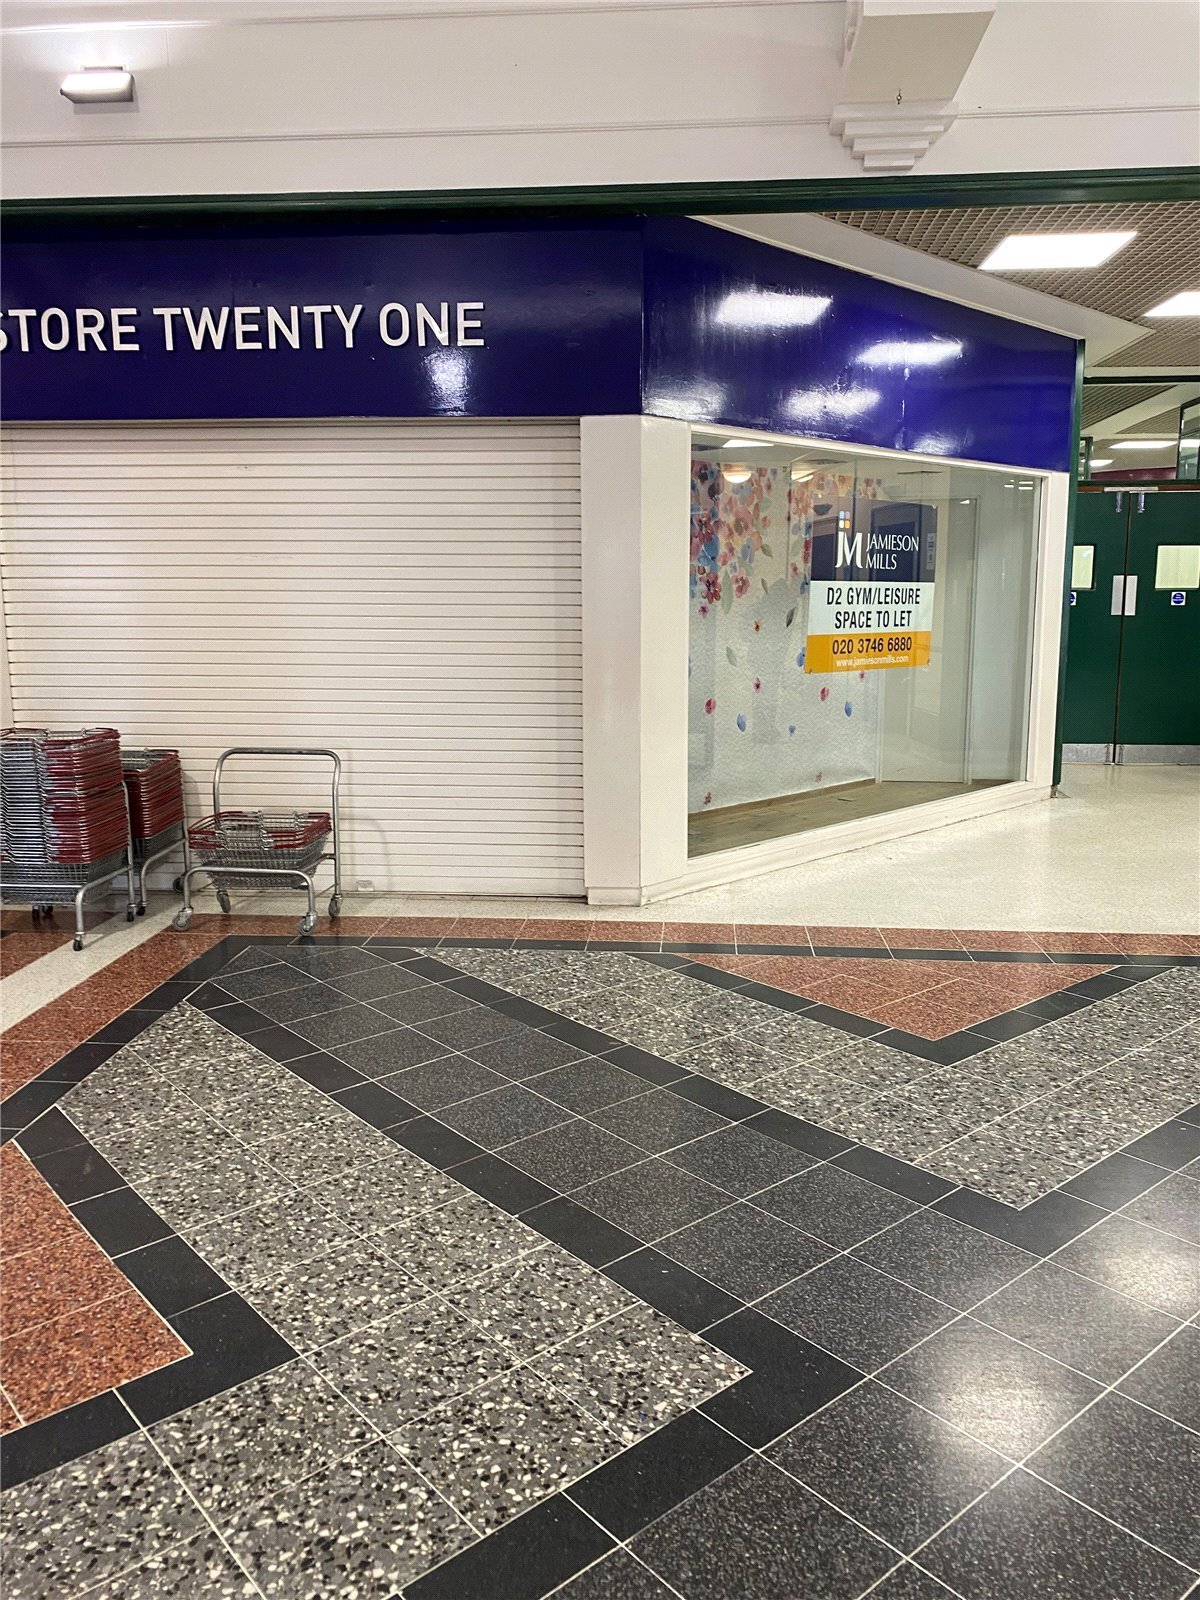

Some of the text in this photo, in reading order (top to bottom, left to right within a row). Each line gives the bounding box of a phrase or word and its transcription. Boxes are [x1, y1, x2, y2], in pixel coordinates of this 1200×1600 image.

[0, 302, 485, 351] TORE TWENTY ONE
[865, 533, 919, 551] JAMIESON
[865, 553, 897, 570] MILLS
[827, 587, 921, 605] D2 GYM/LEISURE
[834, 610, 912, 629] SPACE TO LET
[832, 636, 912, 655] 020 3746 6880
[836, 654, 909, 668] www.jamiesonmills.com
